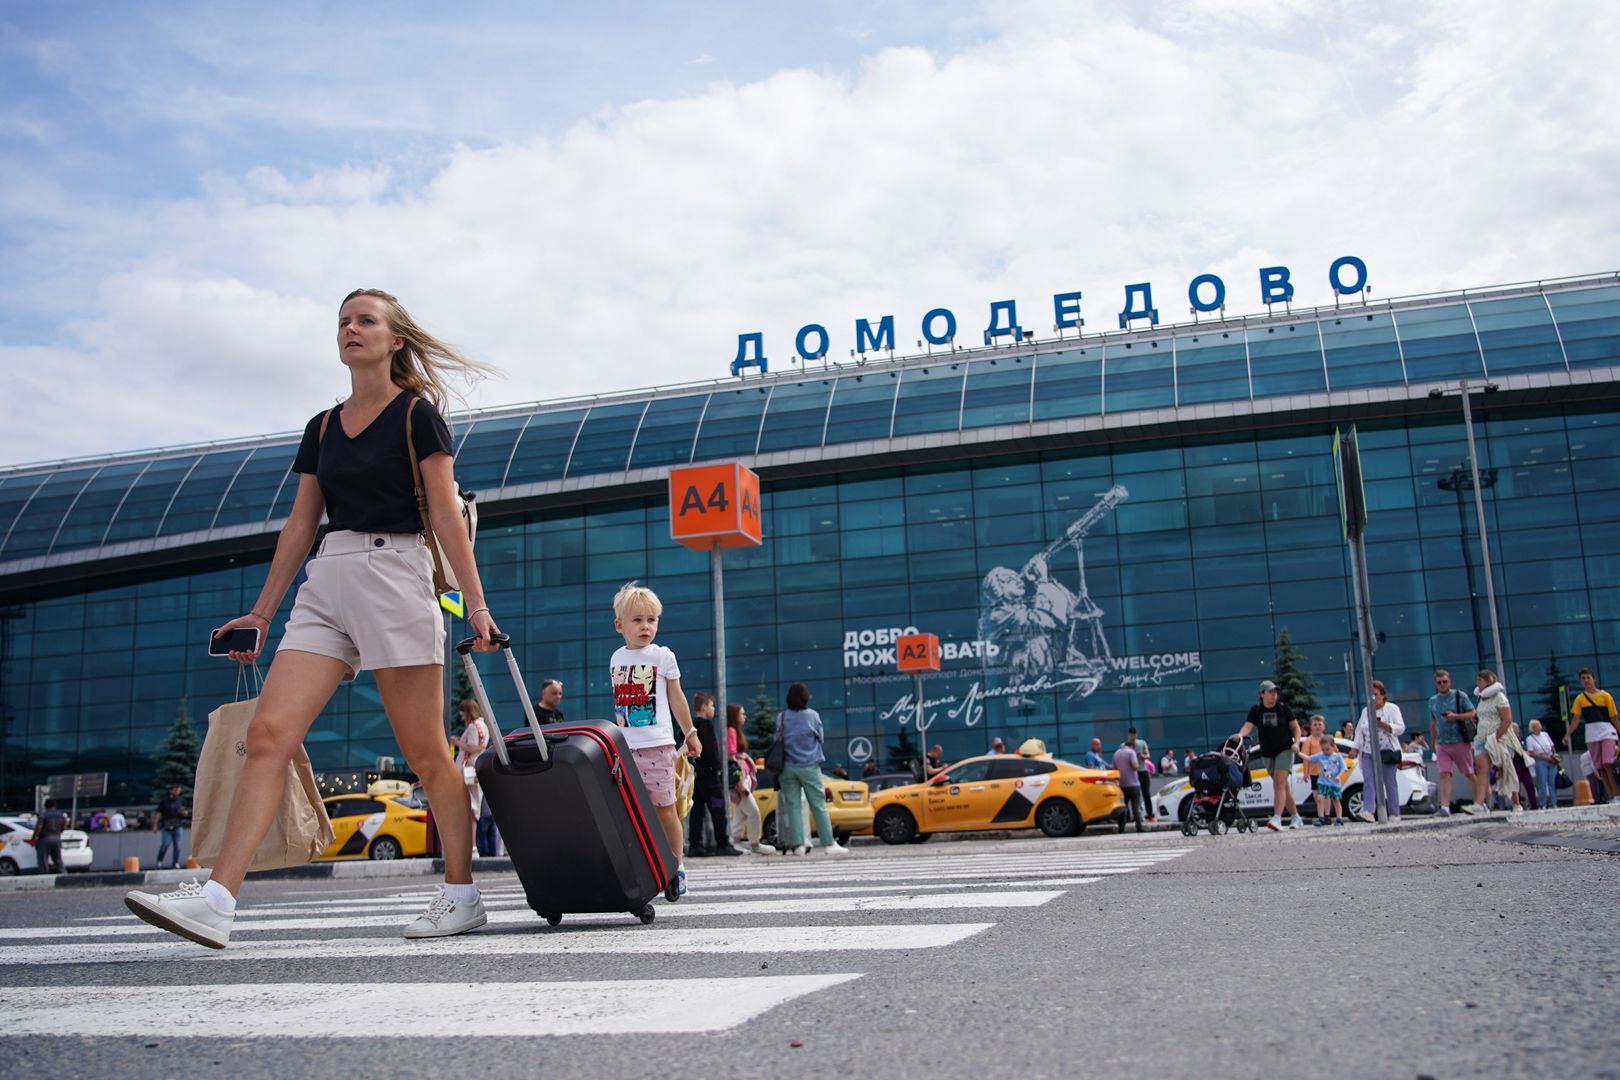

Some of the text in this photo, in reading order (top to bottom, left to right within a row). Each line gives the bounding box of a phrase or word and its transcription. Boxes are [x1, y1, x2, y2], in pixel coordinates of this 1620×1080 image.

[731, 256, 1367, 376] ДОМОДЕДОВО
[679, 482, 729, 516] A4
[844, 640, 1000, 667] ПОЖВАТЬ
[902, 643, 927, 660] A2
[1111, 652, 1200, 670] WELCOME
